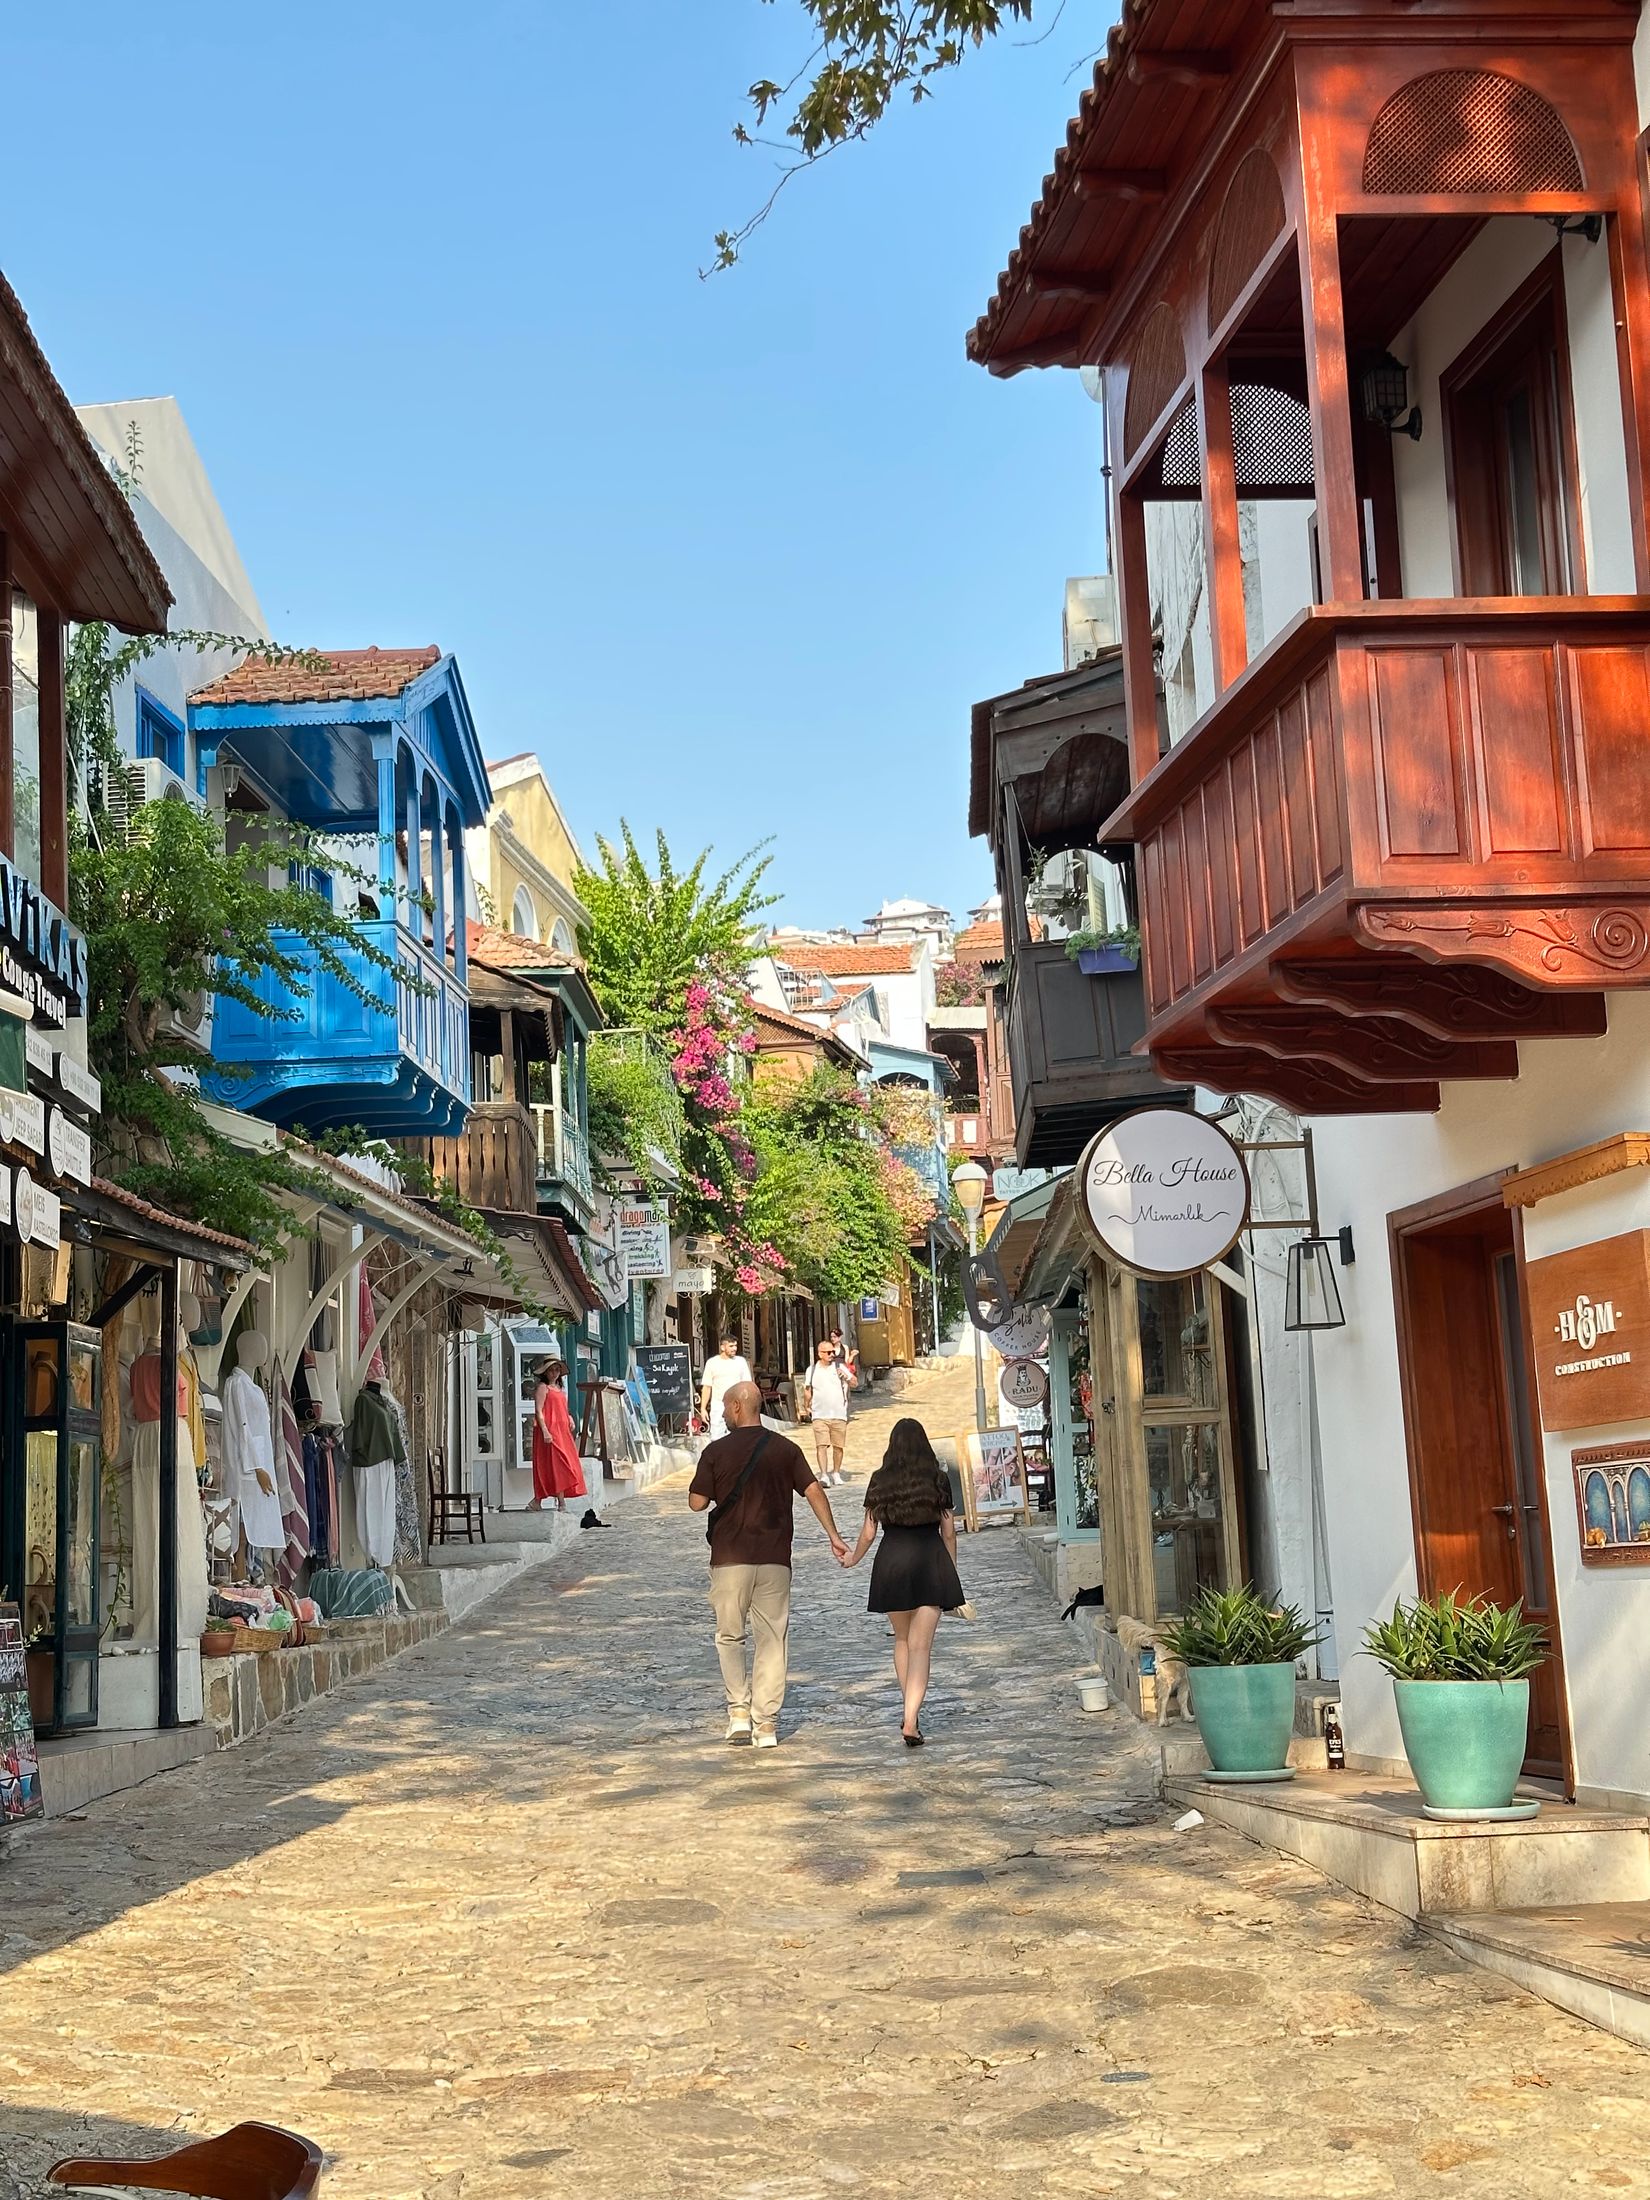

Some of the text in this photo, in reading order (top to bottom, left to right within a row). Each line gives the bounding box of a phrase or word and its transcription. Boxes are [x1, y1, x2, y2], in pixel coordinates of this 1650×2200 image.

[35, 972, 66, 1030] Travel
[65, 1124, 86, 1153] TRANSFER
[1093, 1157, 1237, 1187] Bella House
[678, 1280, 705, 1289] mayo
[1558, 1295, 1616, 1350] H&M
[1555, 1351, 1632, 1376] CONSTRUCTION
[1012, 1385, 1039, 1395] RADU
